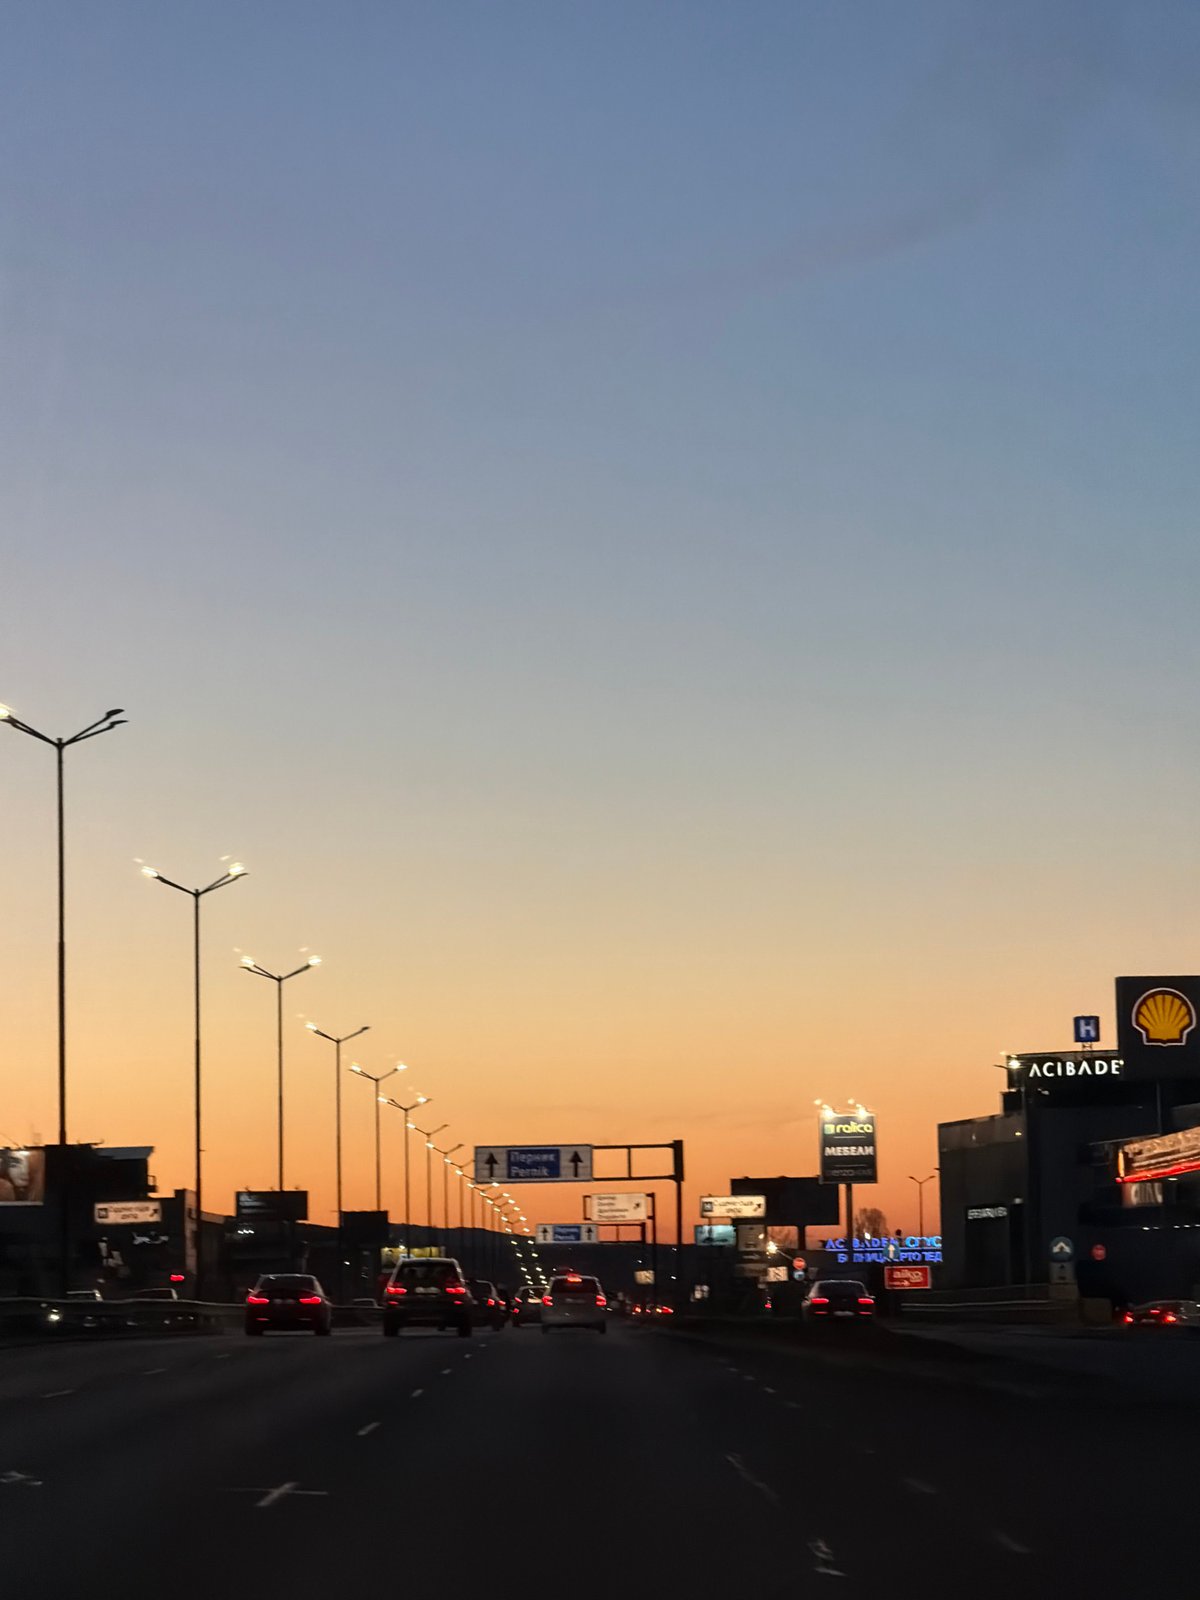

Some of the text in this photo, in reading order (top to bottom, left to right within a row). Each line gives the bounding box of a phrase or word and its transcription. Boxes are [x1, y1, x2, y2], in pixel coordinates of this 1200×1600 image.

[1079, 1019, 1096, 1038] H
[824, 1146, 874, 1156] МЕБЕЛИ
[510, 1166, 549, 1177] Pernik
